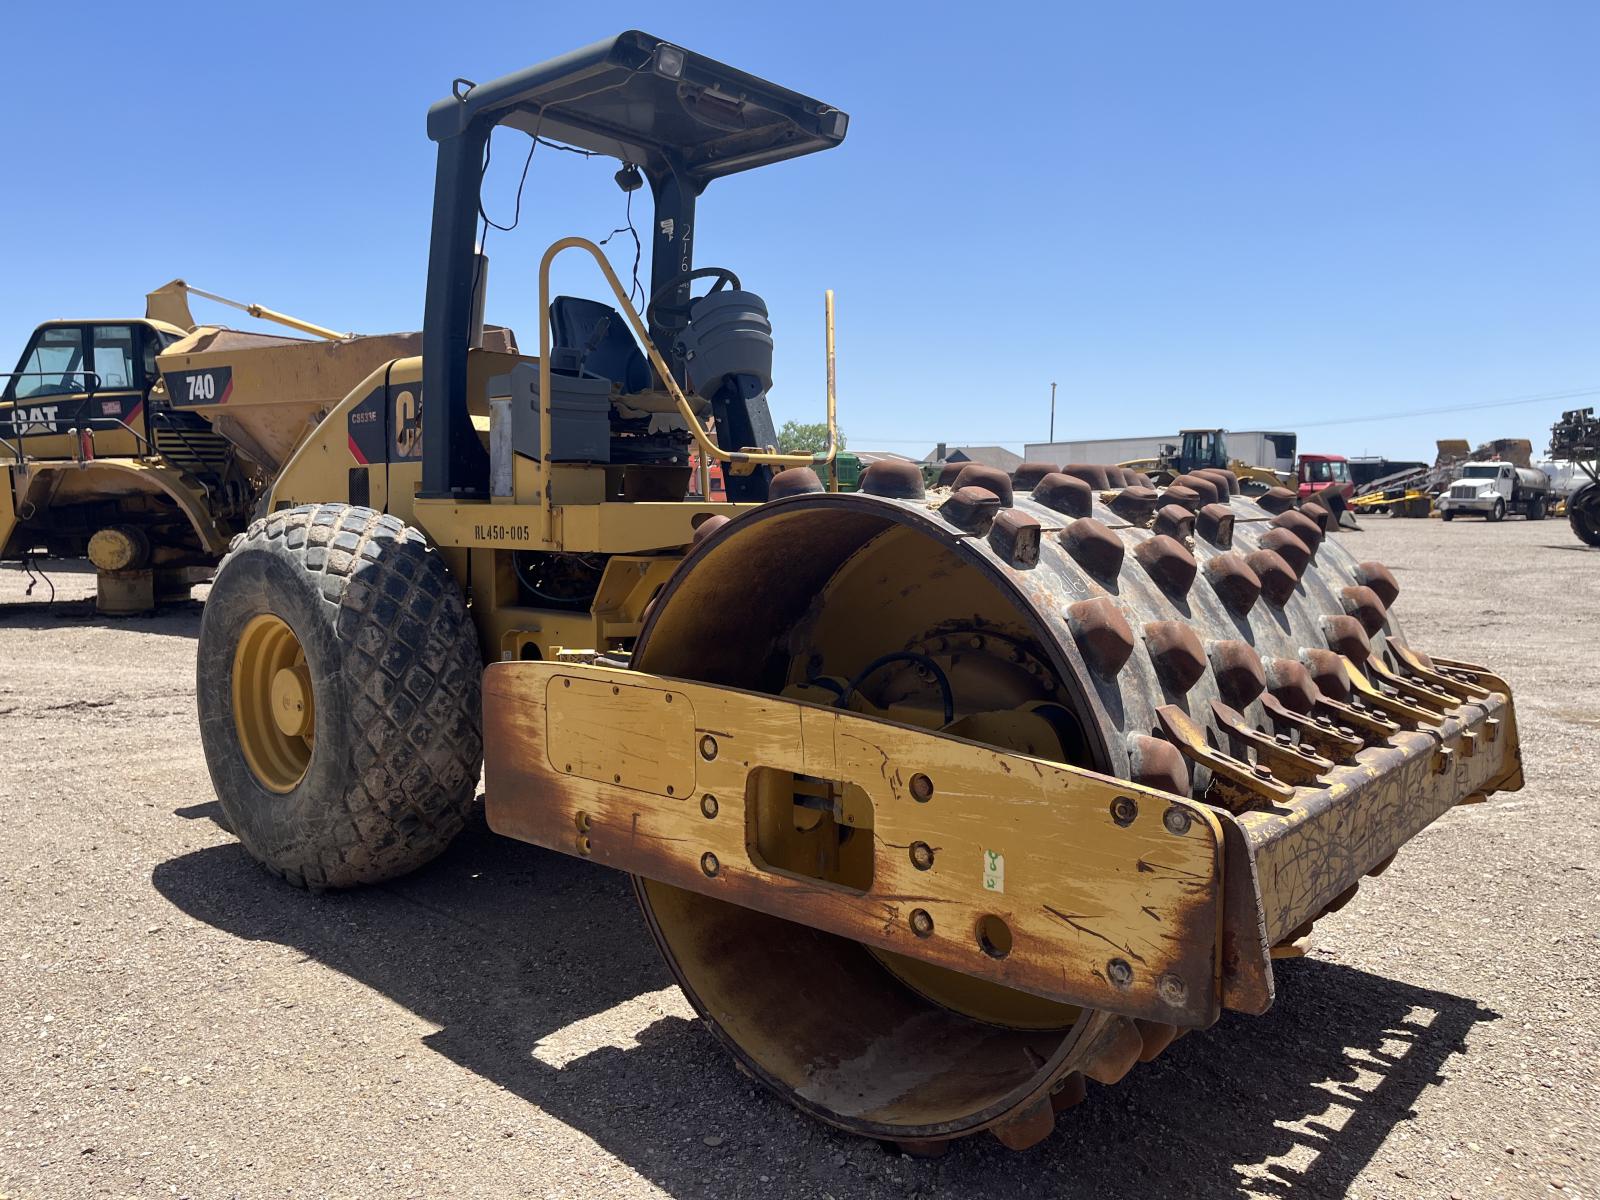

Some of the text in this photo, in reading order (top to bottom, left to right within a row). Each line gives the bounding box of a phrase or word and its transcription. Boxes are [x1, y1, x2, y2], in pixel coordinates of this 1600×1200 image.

[186, 373, 215, 401] 740
[11, 406, 58, 435] CAT
[474, 524, 530, 541] RL450-005
